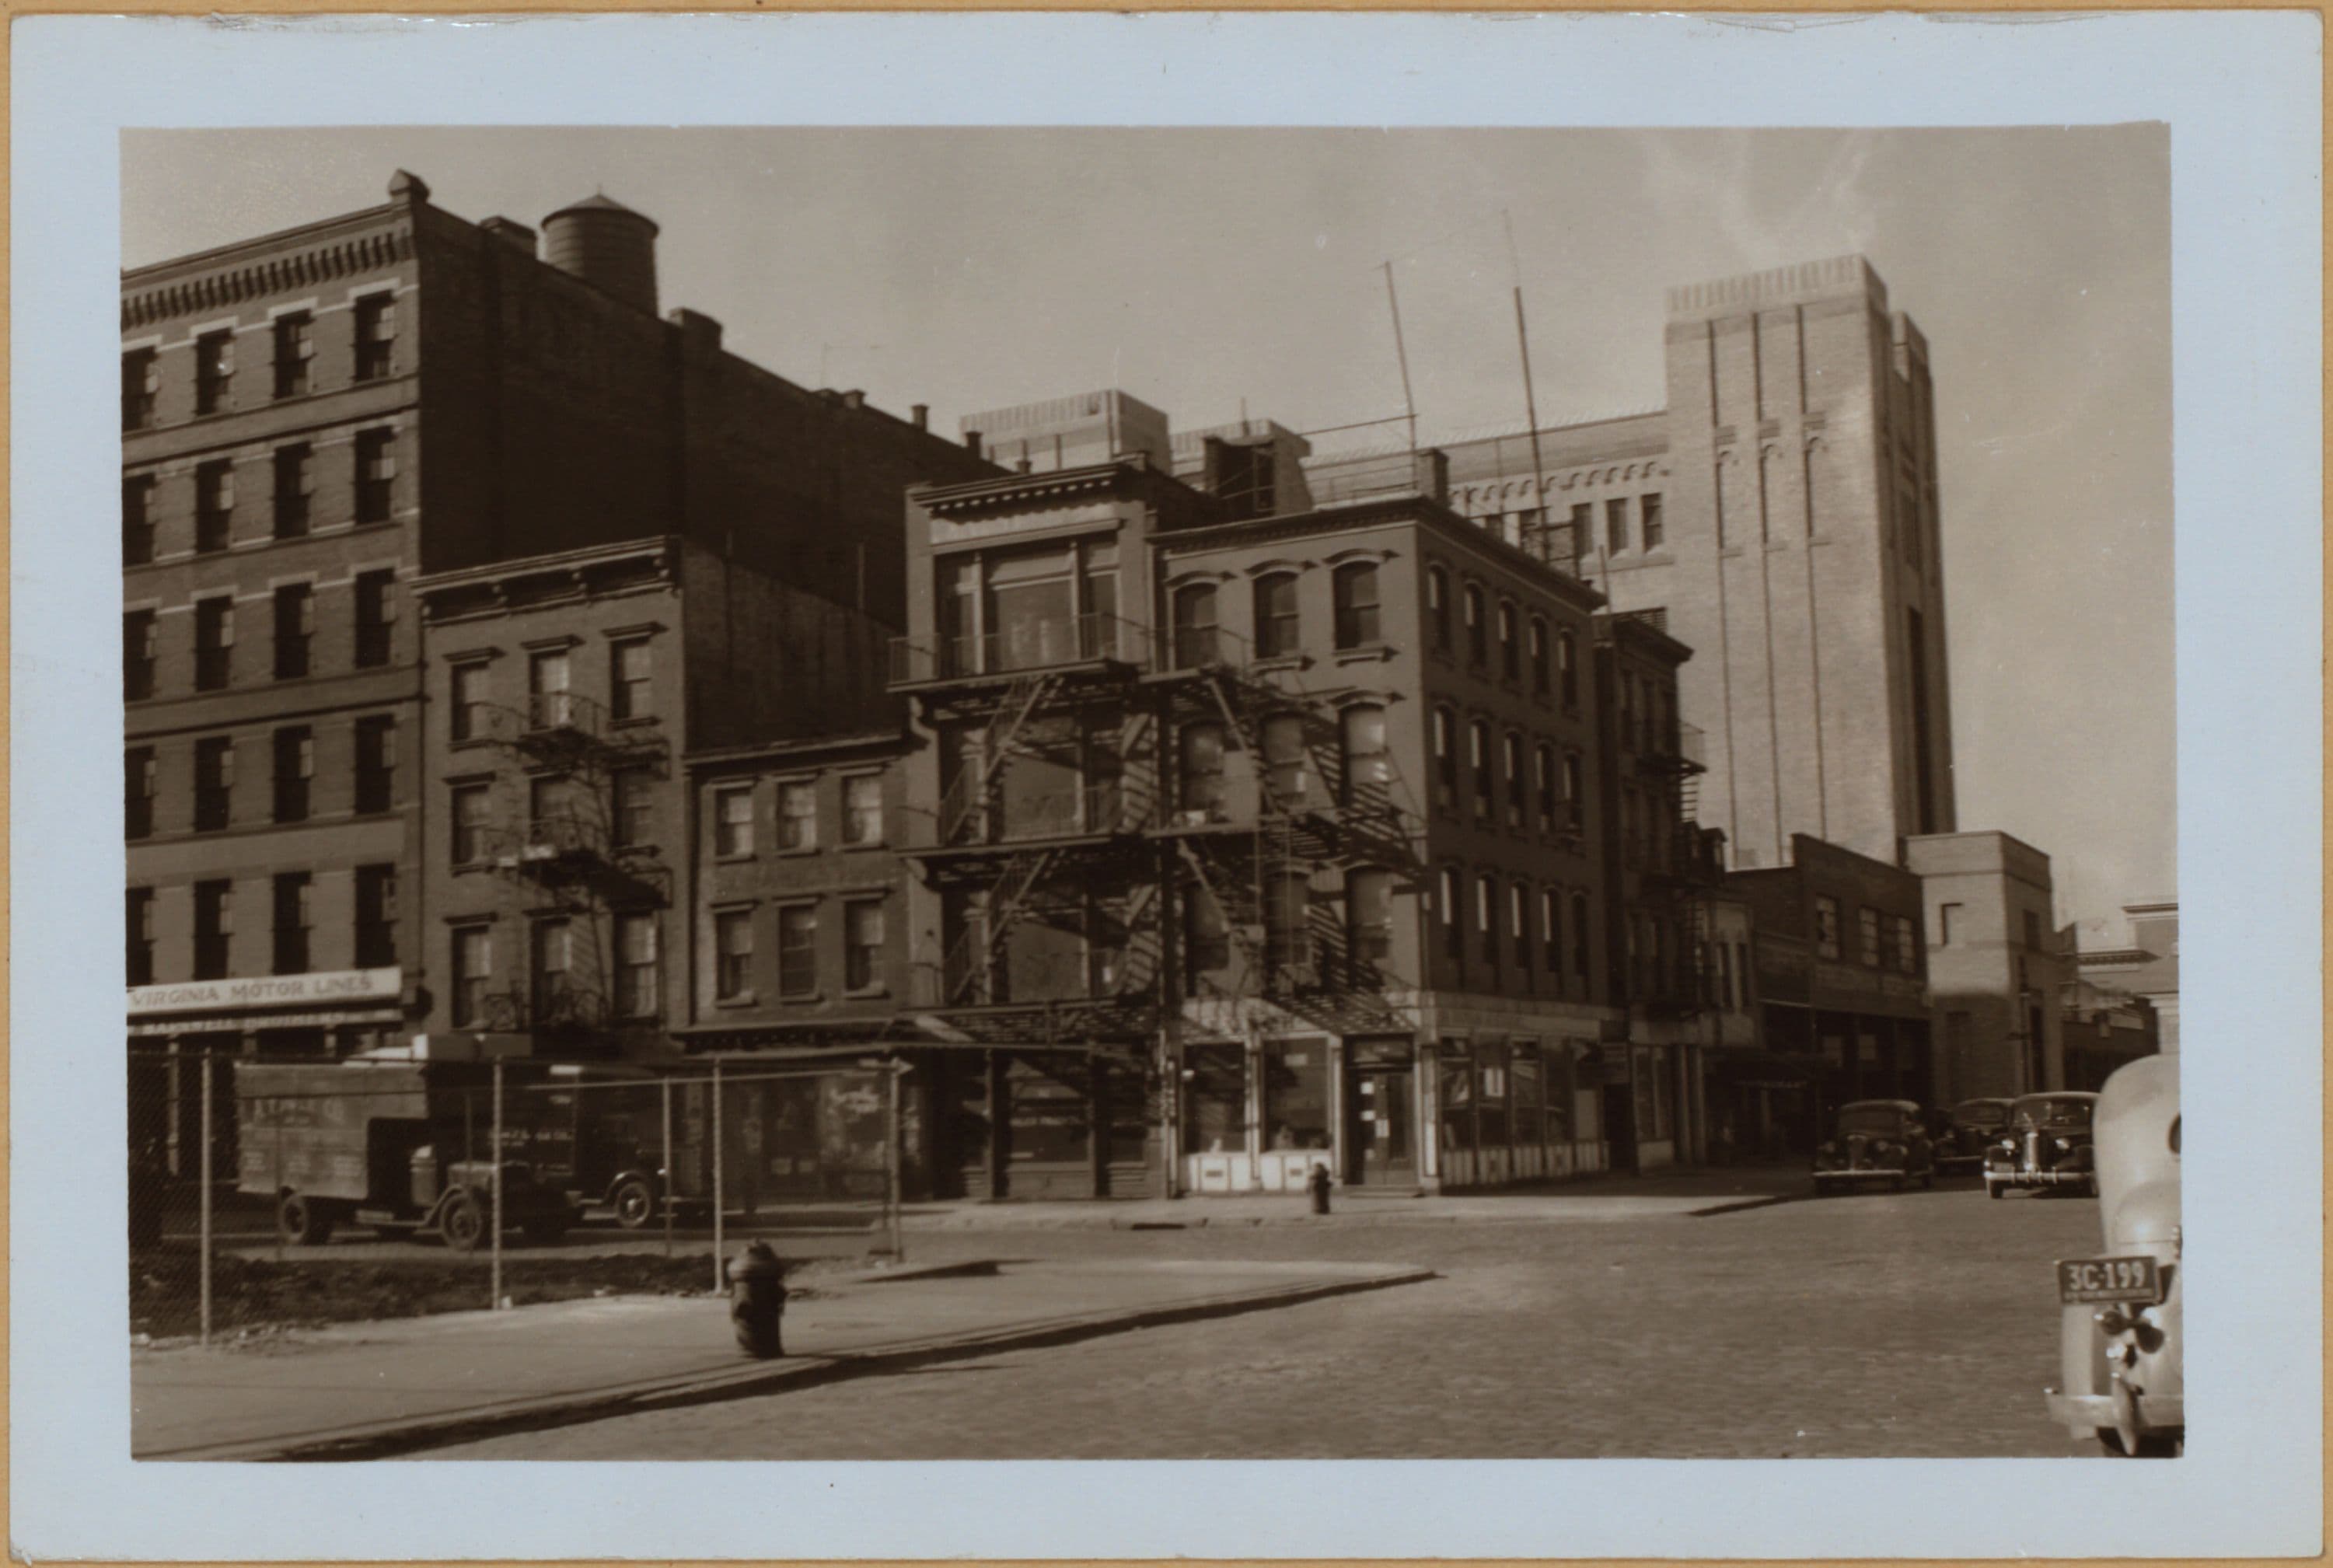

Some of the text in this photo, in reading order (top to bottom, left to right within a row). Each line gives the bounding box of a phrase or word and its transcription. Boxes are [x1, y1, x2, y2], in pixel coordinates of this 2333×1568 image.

[131, 976, 373, 1008] VIRGINIA MOTOR LINES
